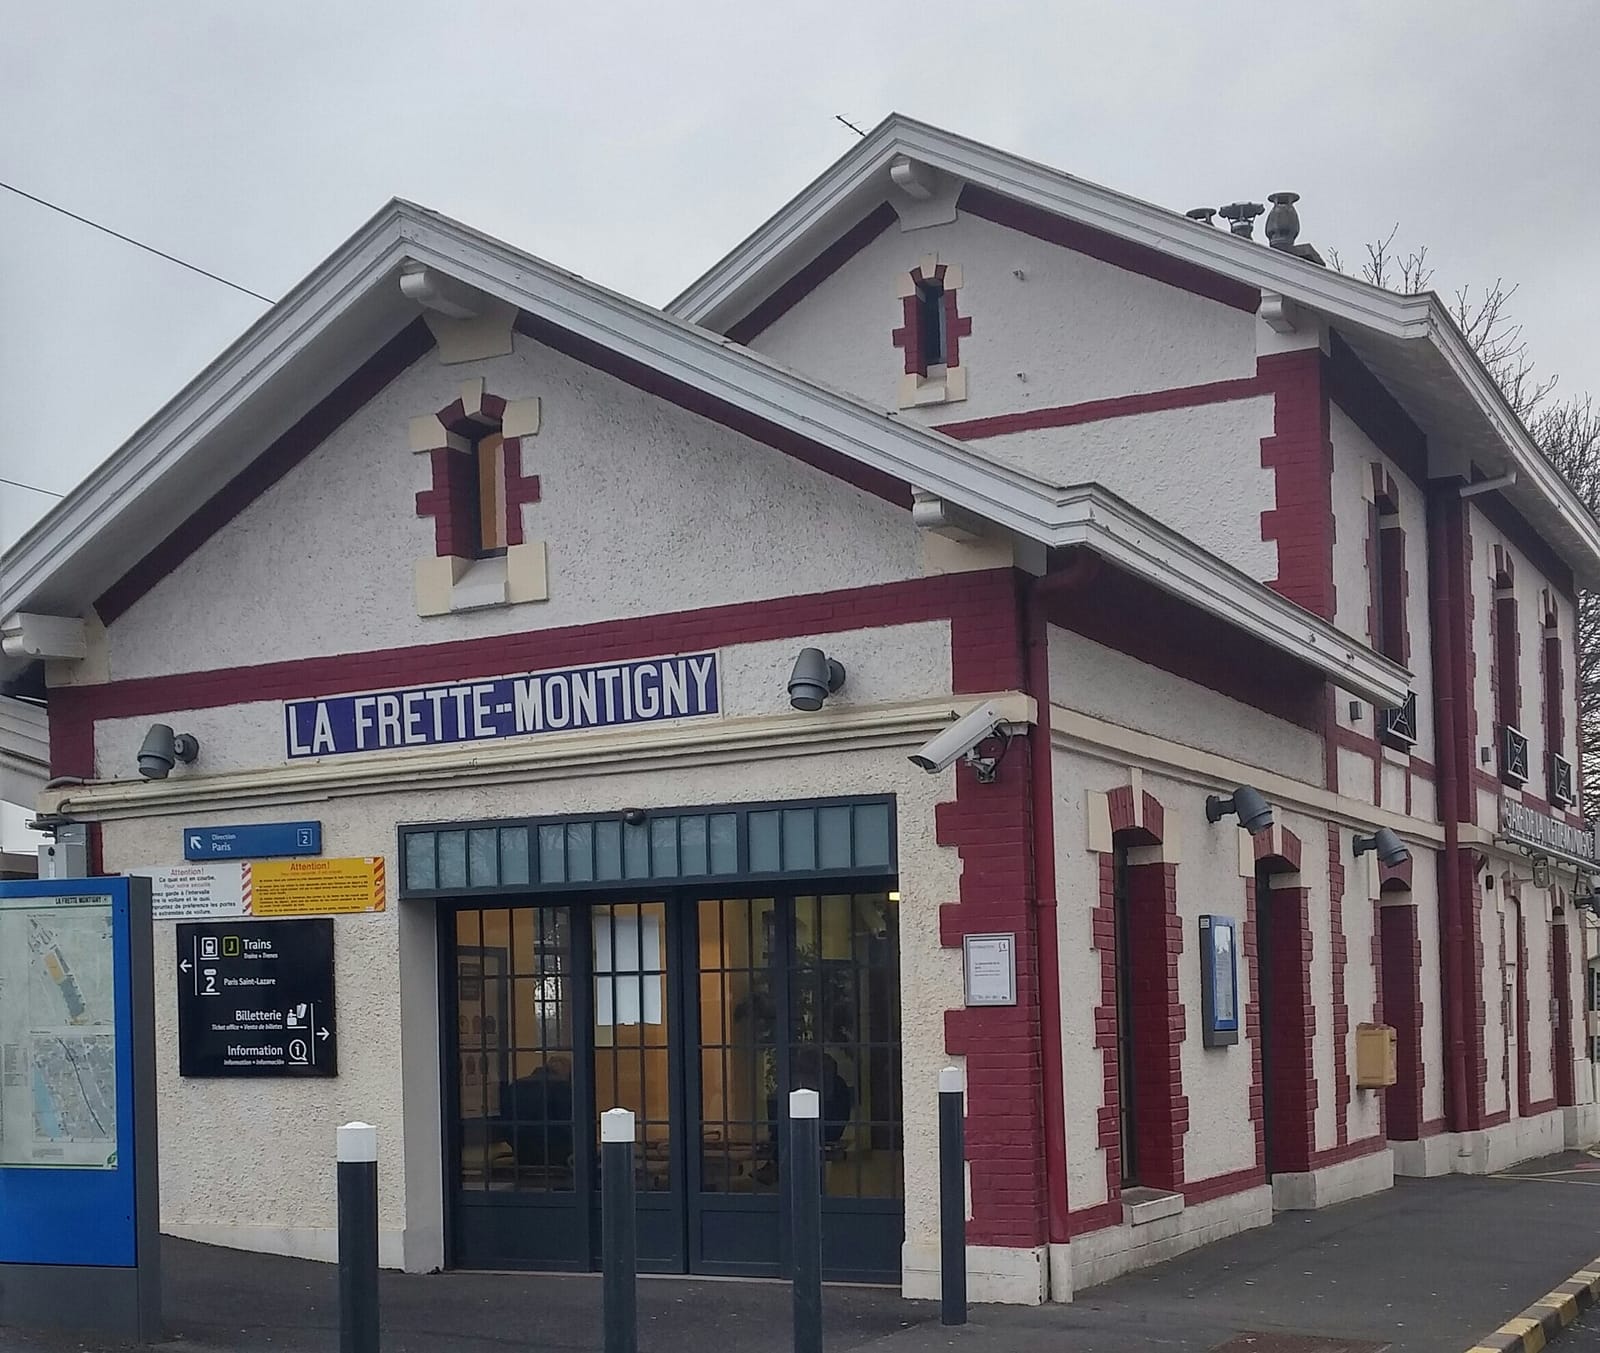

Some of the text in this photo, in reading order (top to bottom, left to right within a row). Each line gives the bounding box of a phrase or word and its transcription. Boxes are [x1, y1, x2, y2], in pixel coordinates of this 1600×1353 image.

[288, 656, 713, 756] LA FRETTE-MONTIGNY
[211, 833, 237, 841] Direction
[302, 835, 308, 844] 2
[211, 843, 232, 852] Paris
[242, 939, 272, 950] Trains
[205, 976, 276, 992] 2 Paris Saint-Lazare
[235, 1009, 282, 1021] Billetterie
[227, 1044, 283, 1056] Information
